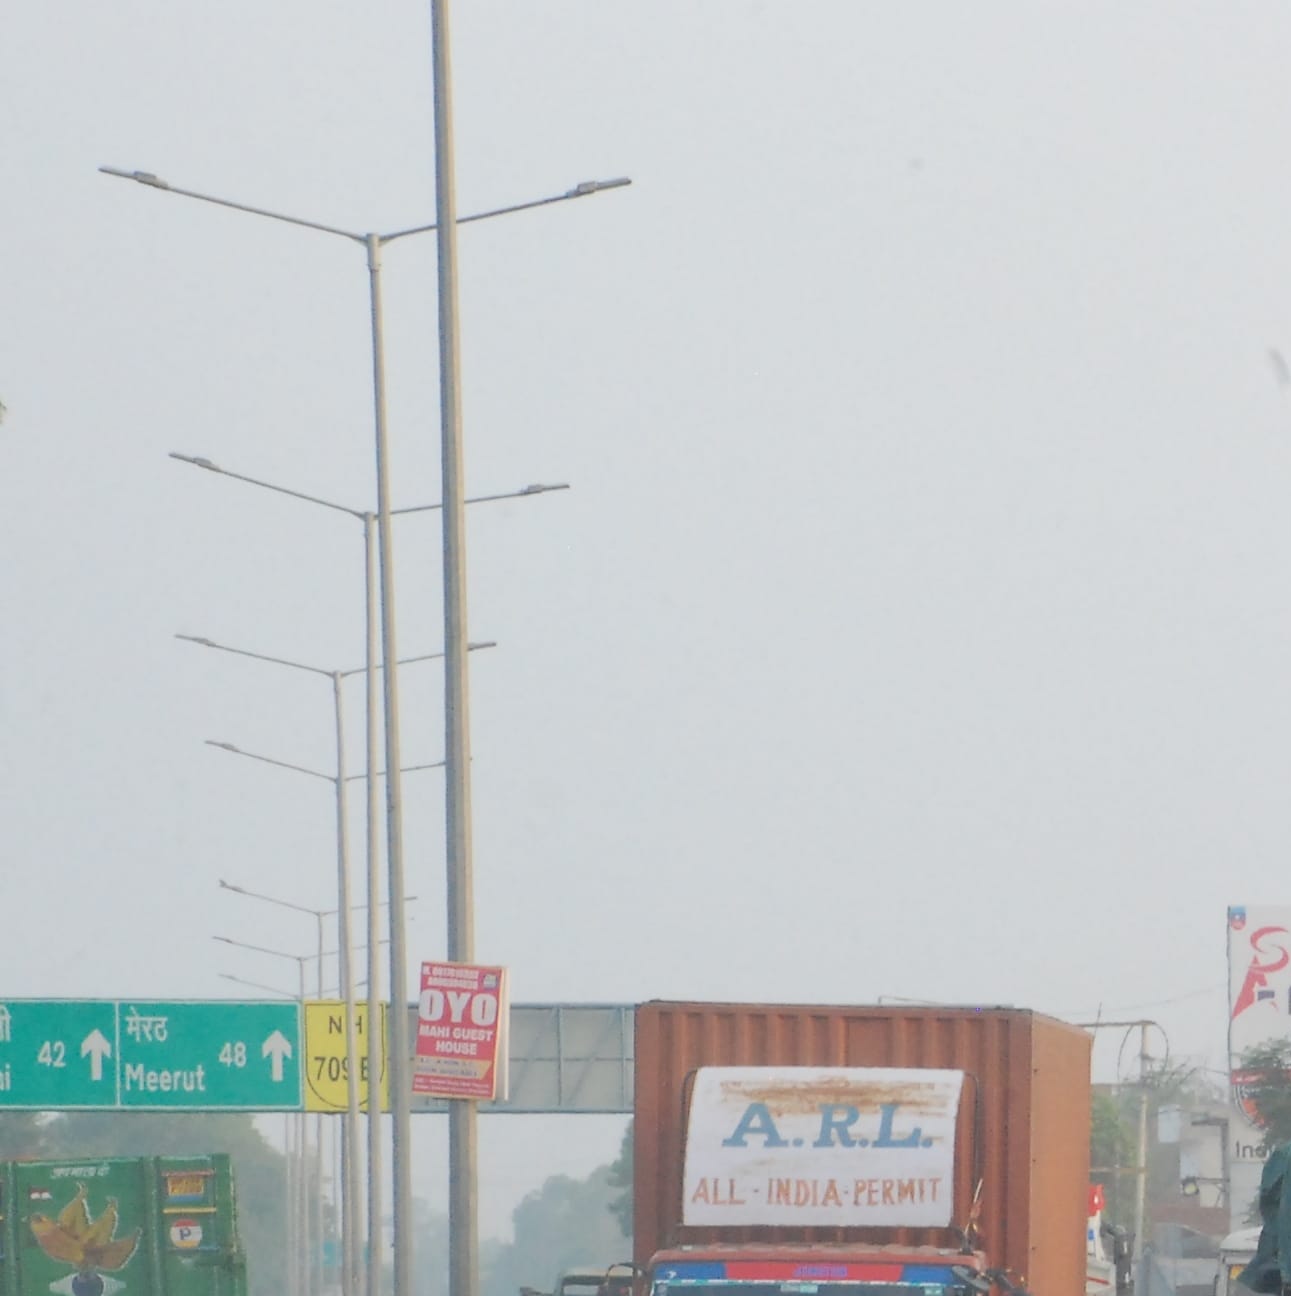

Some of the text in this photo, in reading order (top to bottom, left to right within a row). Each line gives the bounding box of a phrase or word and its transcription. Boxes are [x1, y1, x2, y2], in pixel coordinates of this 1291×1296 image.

[419, 988, 498, 1026] OYO
[126, 1008, 169, 1043] मेरठ
[419, 1024, 494, 1041] MAHI GUEST
[37, 1041, 66, 1068] 42
[218, 1041, 247, 1068] 48
[435, 1040, 477, 1056] HOUSE
[124, 1063, 206, 1092] Meerut
[692, 1177, 942, 1208] ALL INDIA PERMIT
